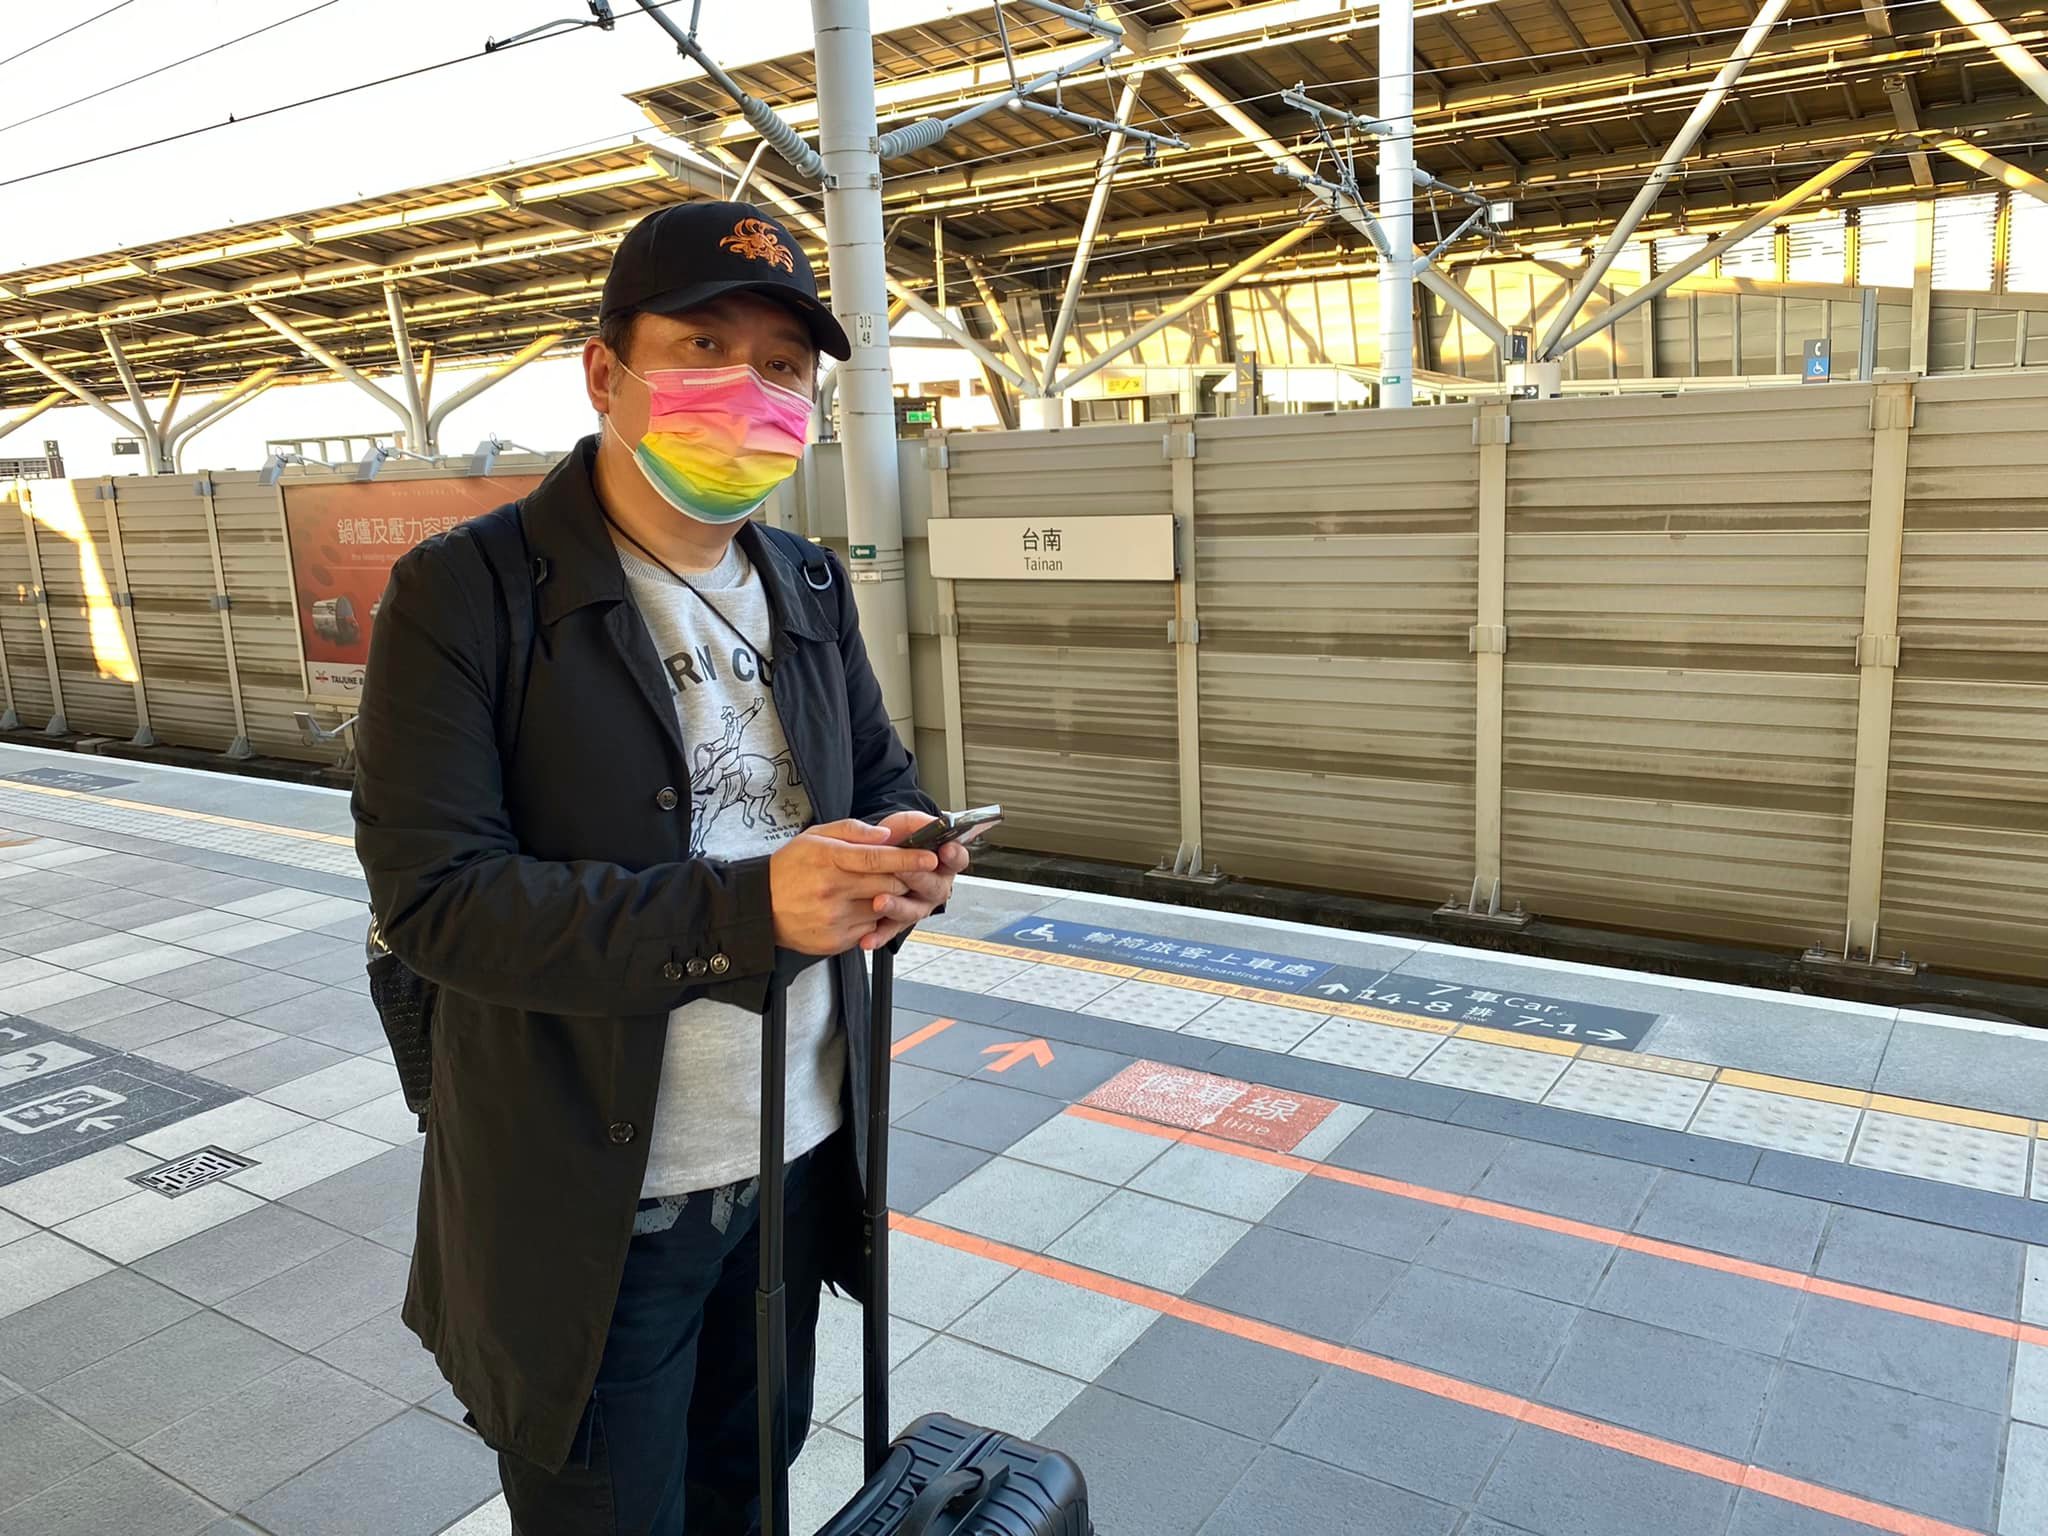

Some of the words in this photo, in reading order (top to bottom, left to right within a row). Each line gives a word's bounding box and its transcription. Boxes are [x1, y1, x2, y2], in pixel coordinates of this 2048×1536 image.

[859, 315, 872, 329] 313
[862, 331, 871, 344] 48
[1022, 527, 1063, 552] 台南
[1023, 556, 1063, 571] Tainan
[664, 645, 717, 696] RN
[764, 833, 781, 841] THE
[1082, 931, 1317, 978] 輪椅旅客上車處
[1202, 965, 1261, 980] boarding
[1264, 977, 1294, 986] area
[1427, 983, 1463, 996] 7
[1464, 989, 1503, 1003] 車
[1360, 989, 1454, 1013] 14-8
[1464, 1005, 1497, 1018] 排
[1512, 1015, 1578, 1036] 7-1
[1420, 1021, 1449, 1032] gap
